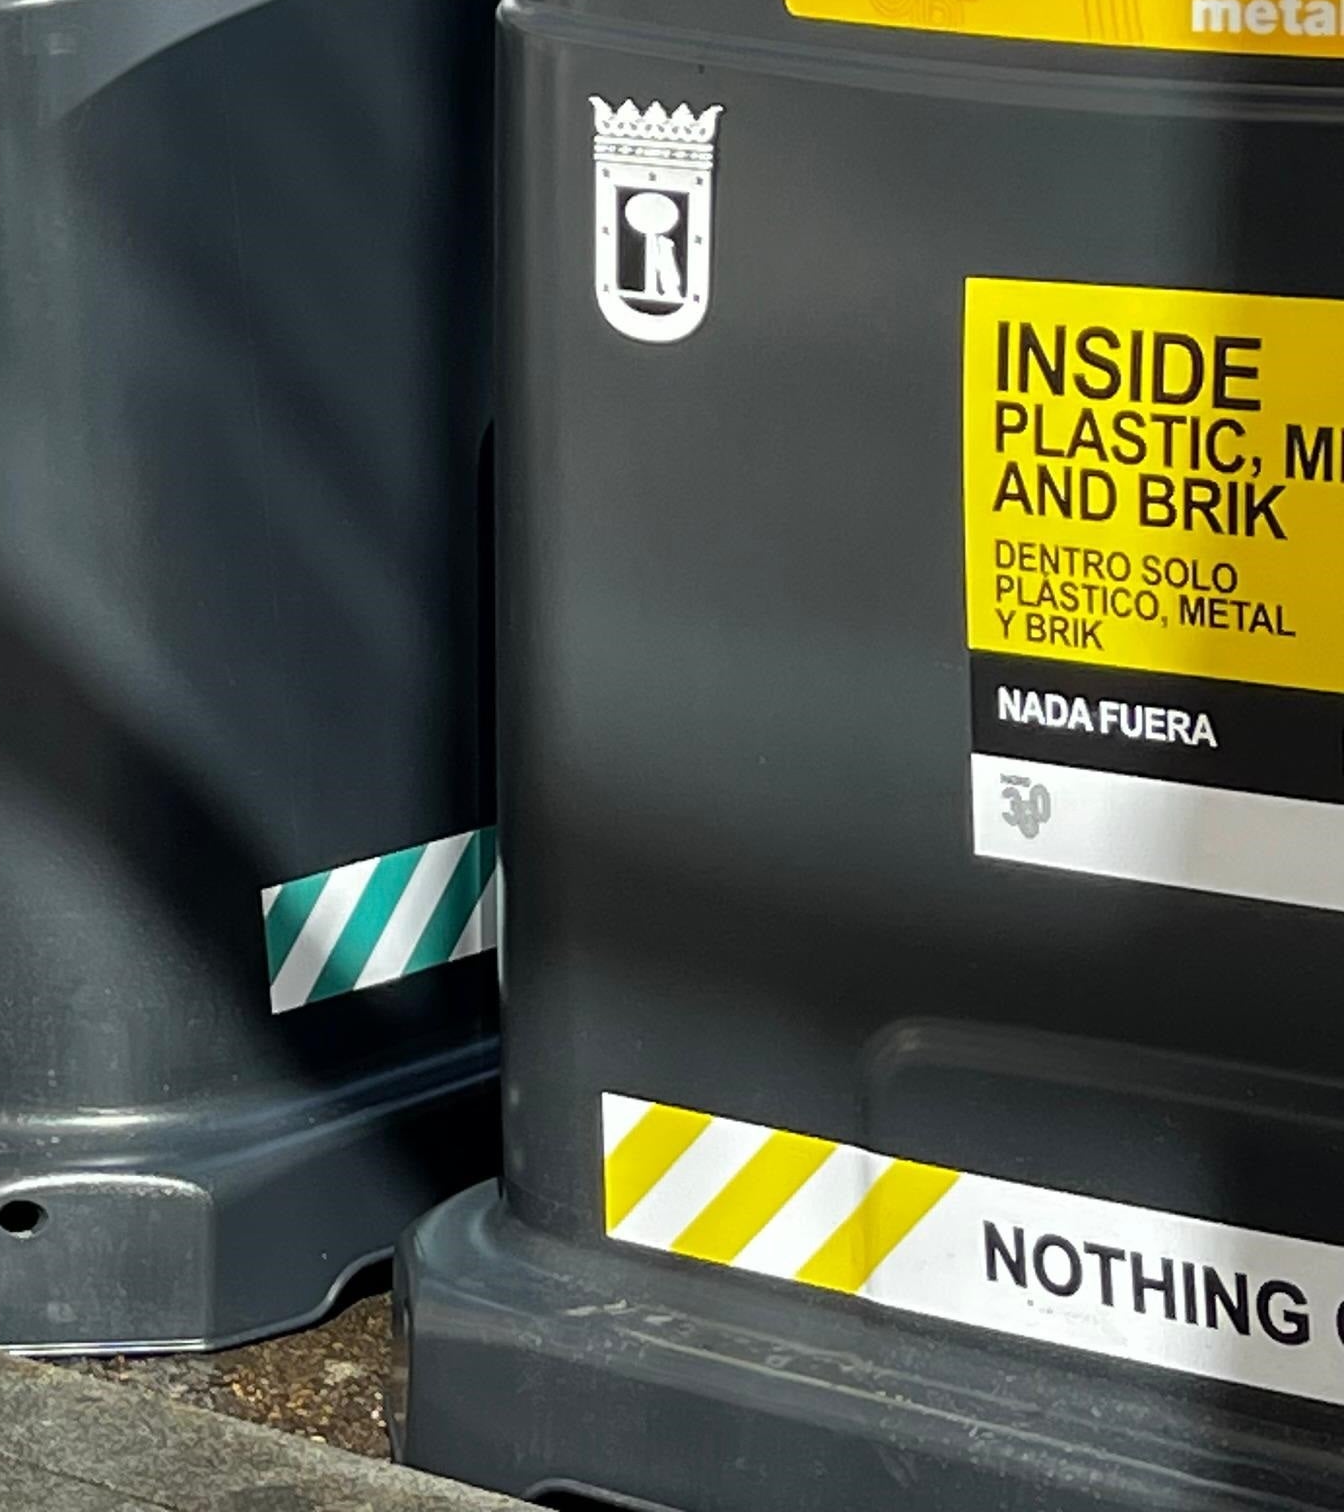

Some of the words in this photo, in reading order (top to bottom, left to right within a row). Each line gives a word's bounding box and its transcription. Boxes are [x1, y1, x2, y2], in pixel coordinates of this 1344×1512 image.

[996, 320, 1262, 411] INSIDE
[996, 400, 1262, 477] PLASTIC,
[993, 461, 1118, 522] AND
[1139, 473, 1288, 541] BRIK
[996, 539, 1131, 582] DENTRO
[1142, 554, 1238, 594] SOLO
[995, 607, 1017, 640] Y
[1027, 613, 1105, 651] BRIK
[996, 572, 1169, 629] PLÁSTICO,
[1180, 594, 1297, 638] METAL
[998, 685, 1094, 734] NADA
[1100, 701, 1219, 749] FUERA
[983, 1220, 1311, 1346] NOTHING
